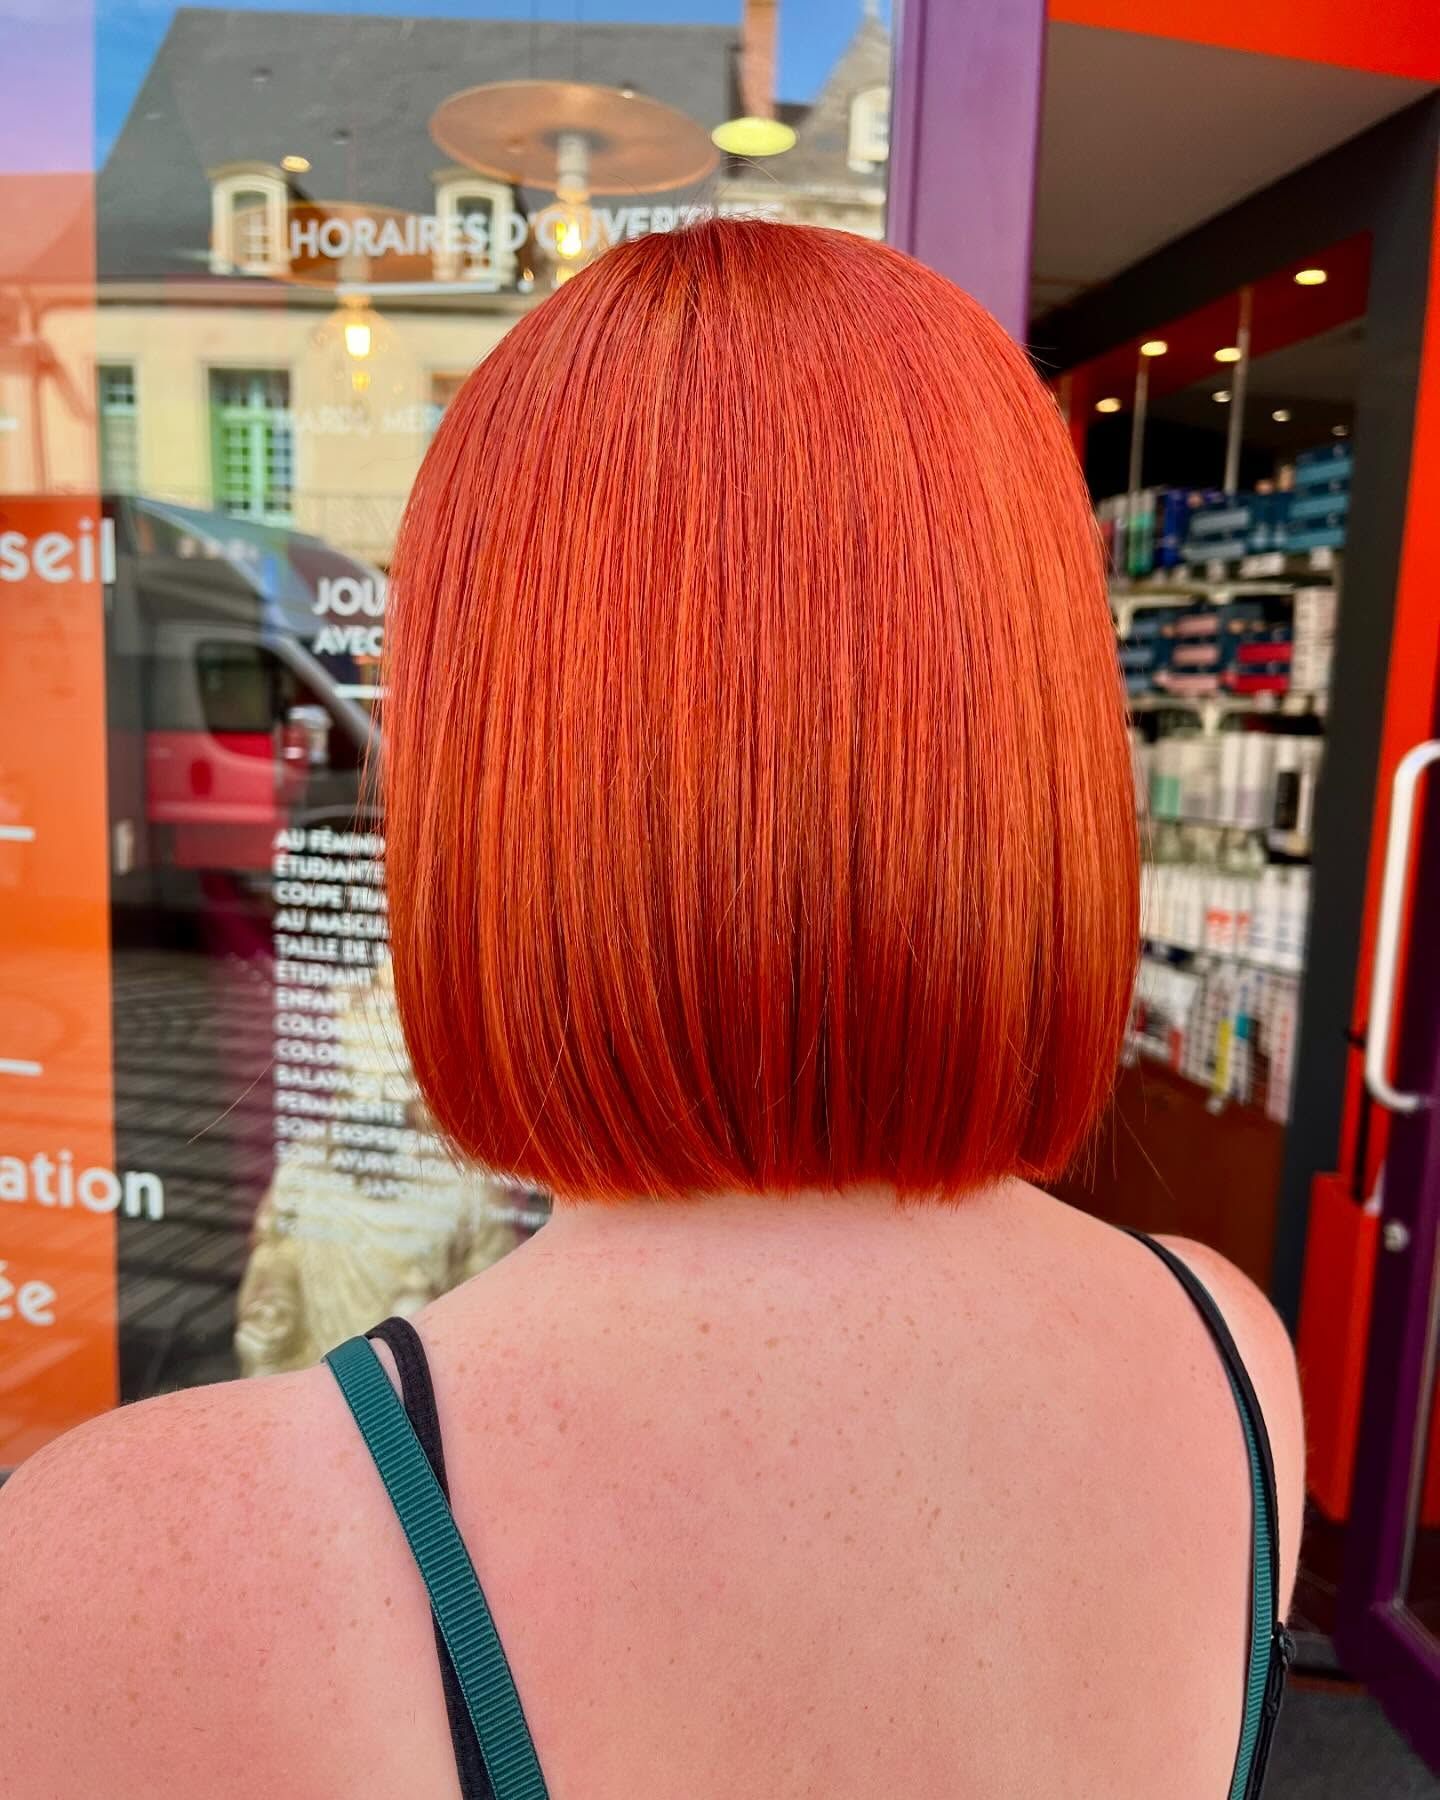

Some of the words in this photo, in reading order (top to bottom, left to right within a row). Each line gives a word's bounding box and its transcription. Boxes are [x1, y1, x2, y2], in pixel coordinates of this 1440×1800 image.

[290, 213, 490, 259] HORAIRES
[503, 203, 783, 253] D'OUVER
[0, 516, 115, 584] seil
[312, 576, 387, 617] JOU
[312, 624, 384, 656] AVEC
[273, 880, 343, 910] COUPE
[0, 1149, 164, 1221] ation
